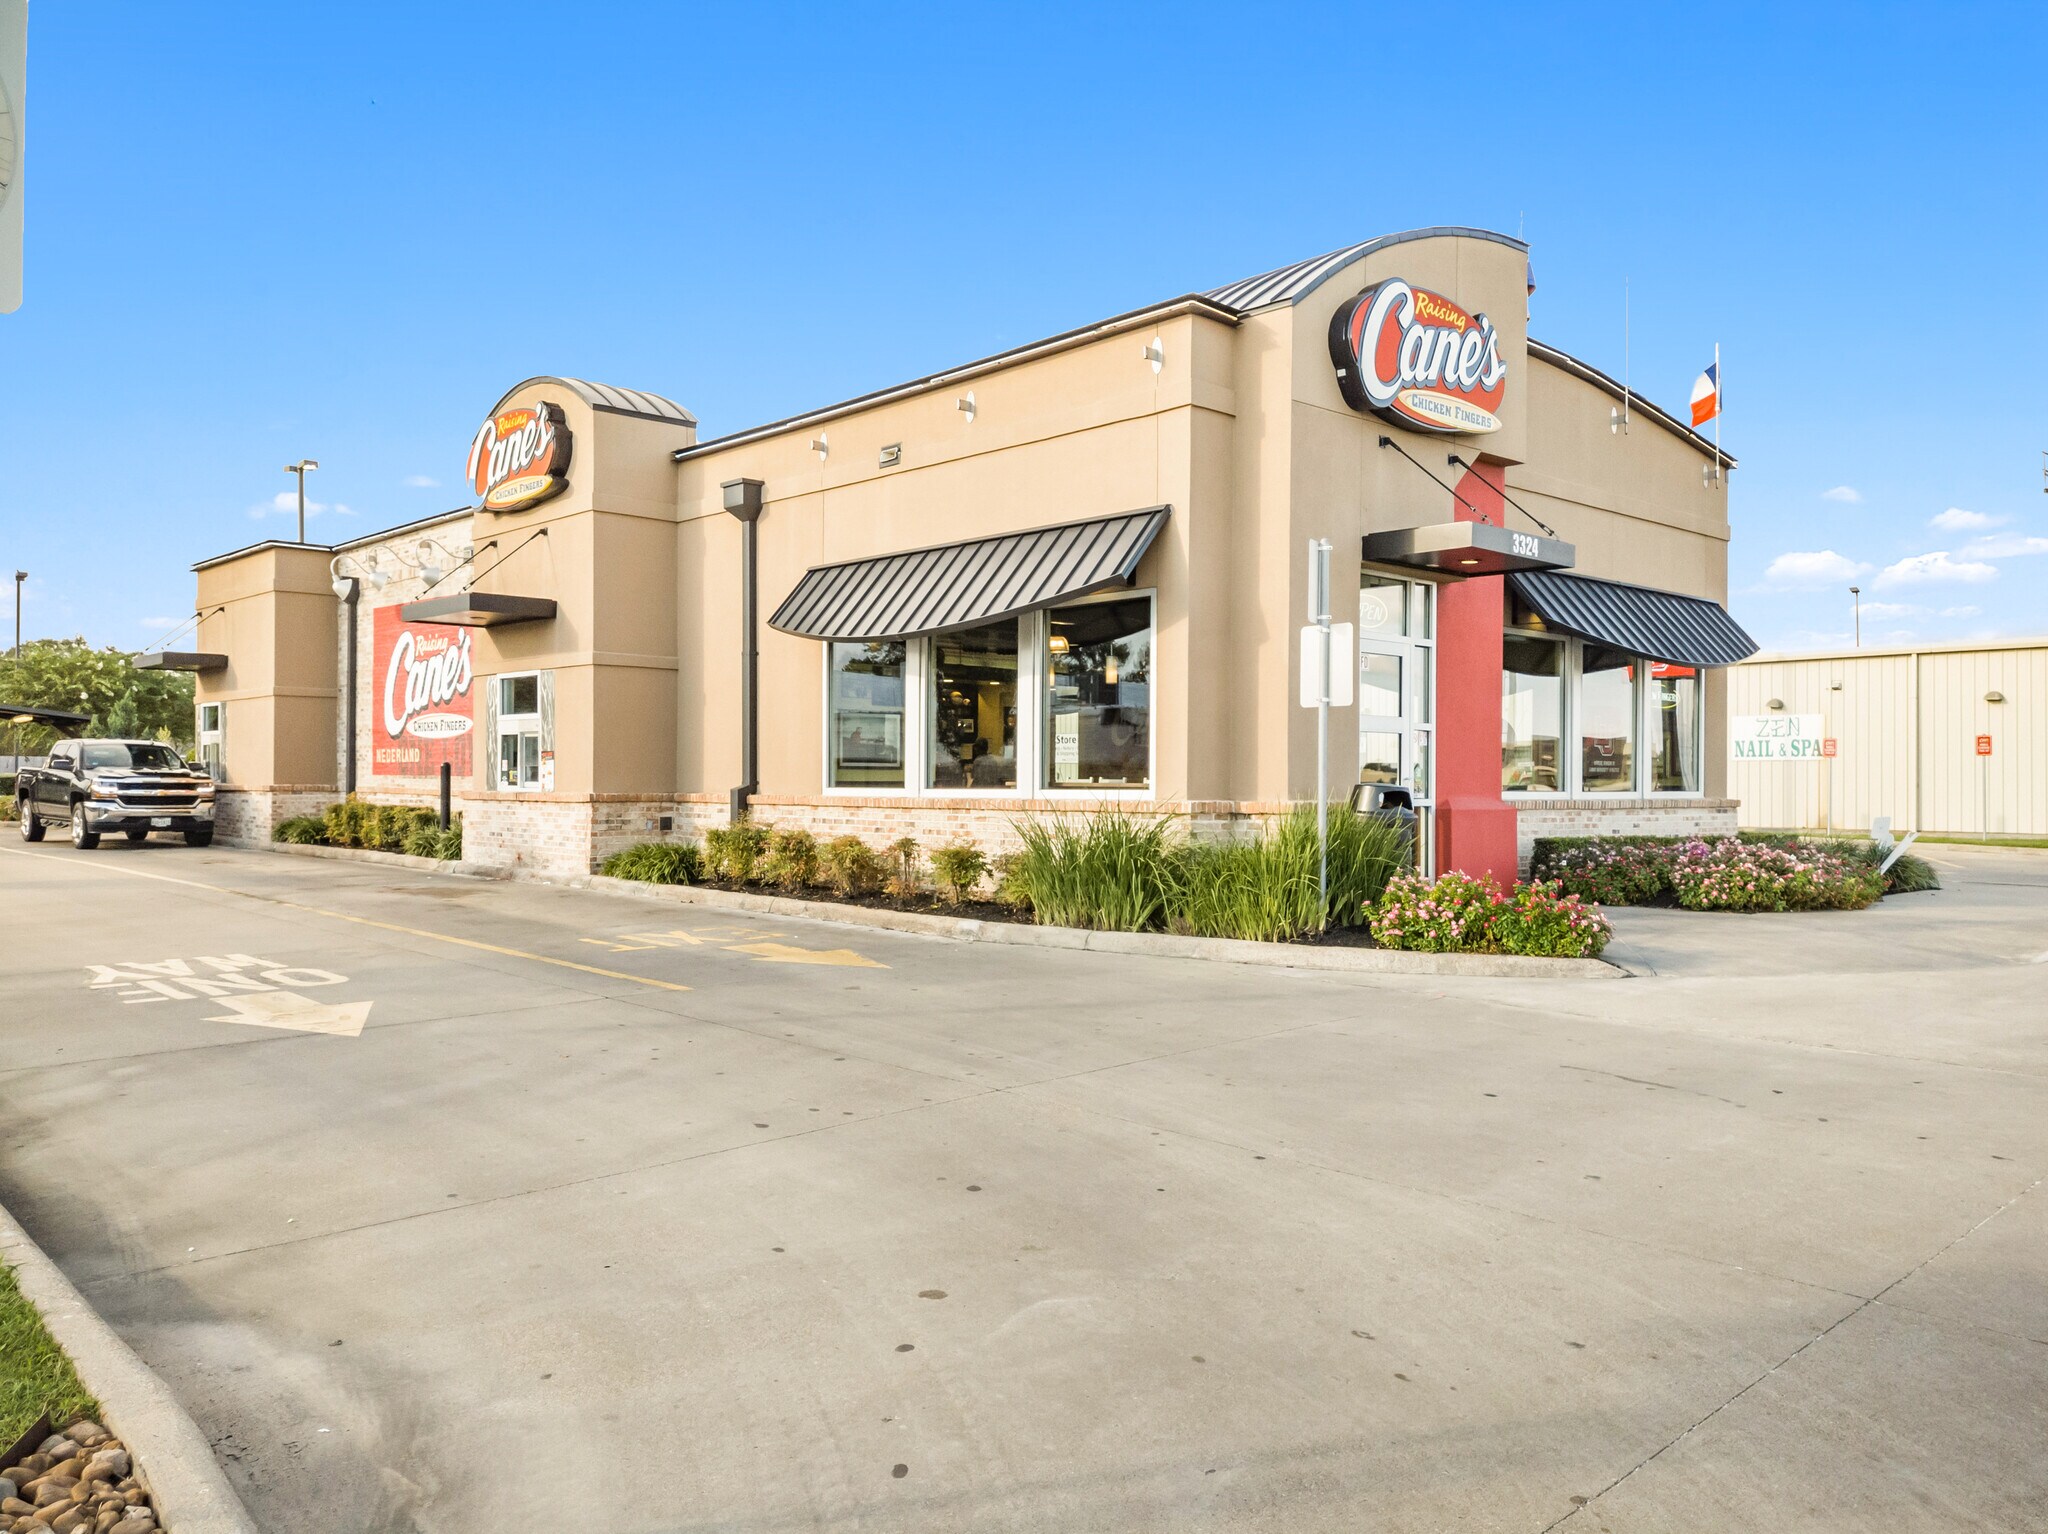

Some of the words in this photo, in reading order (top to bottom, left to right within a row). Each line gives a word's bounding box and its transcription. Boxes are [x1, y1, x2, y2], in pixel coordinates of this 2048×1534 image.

[1415, 293, 1466, 332] Raising
[1359, 280, 1507, 402] Cane's
[1411, 394, 1452, 416] CHICKEN
[1454, 406, 1492, 428] FINGERS
[497, 413, 527, 435] Raising
[469, 402, 554, 507] Cane's
[1512, 533, 1539, 557] 3324
[1360, 602, 1383, 620] PEN
[415, 634, 449, 657] Raising
[384, 626, 473, 736] Cane's
[1056, 735, 1077, 744] Store
[1755, 717, 1800, 738] ZEN
[376, 748, 420, 763] NEDERLAND
[1735, 740, 1774, 757] NAIL
[1779, 742, 1787, 757] &
[1790, 739, 1823, 757] SPA
[85, 953, 289, 984] WAY
[89, 967, 350, 1004] ONE
